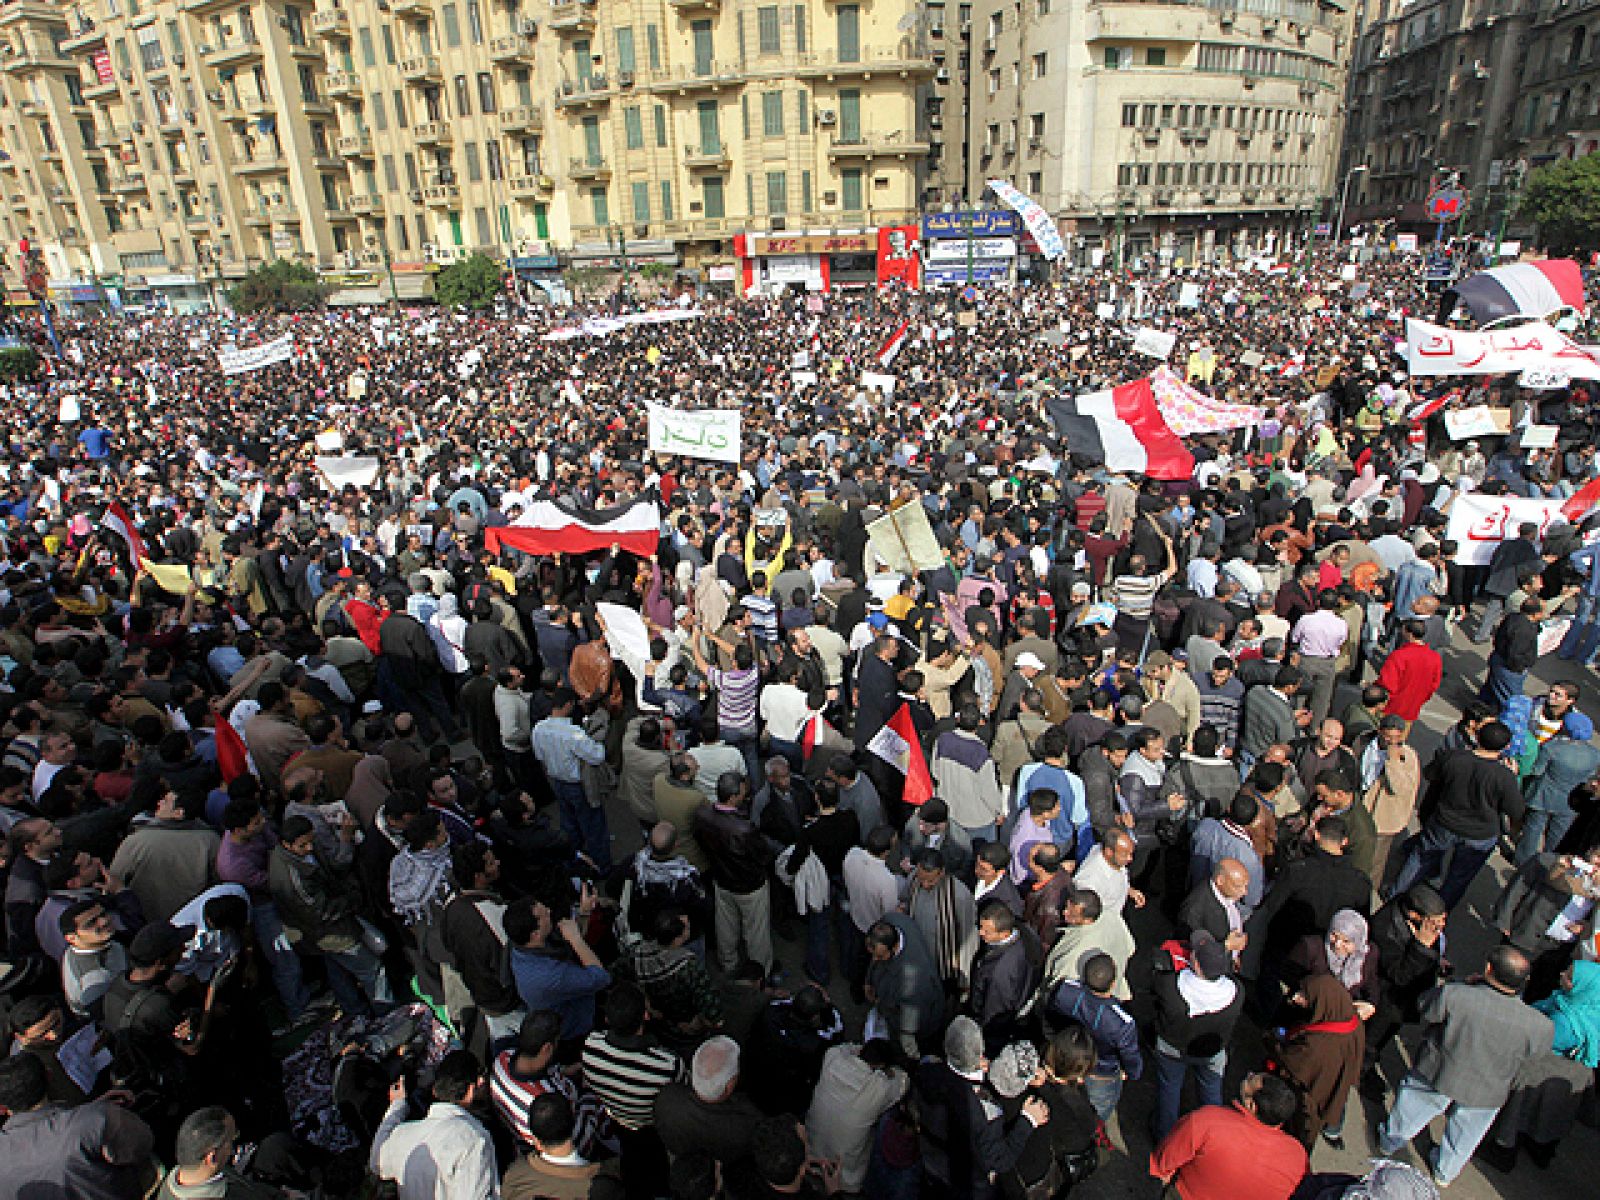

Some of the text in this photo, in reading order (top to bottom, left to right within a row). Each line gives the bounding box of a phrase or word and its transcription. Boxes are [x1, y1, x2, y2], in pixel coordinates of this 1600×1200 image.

[1434, 198, 1460, 213] M
[767, 239, 797, 253] KFC
[1418, 334, 1543, 367] مبارك
